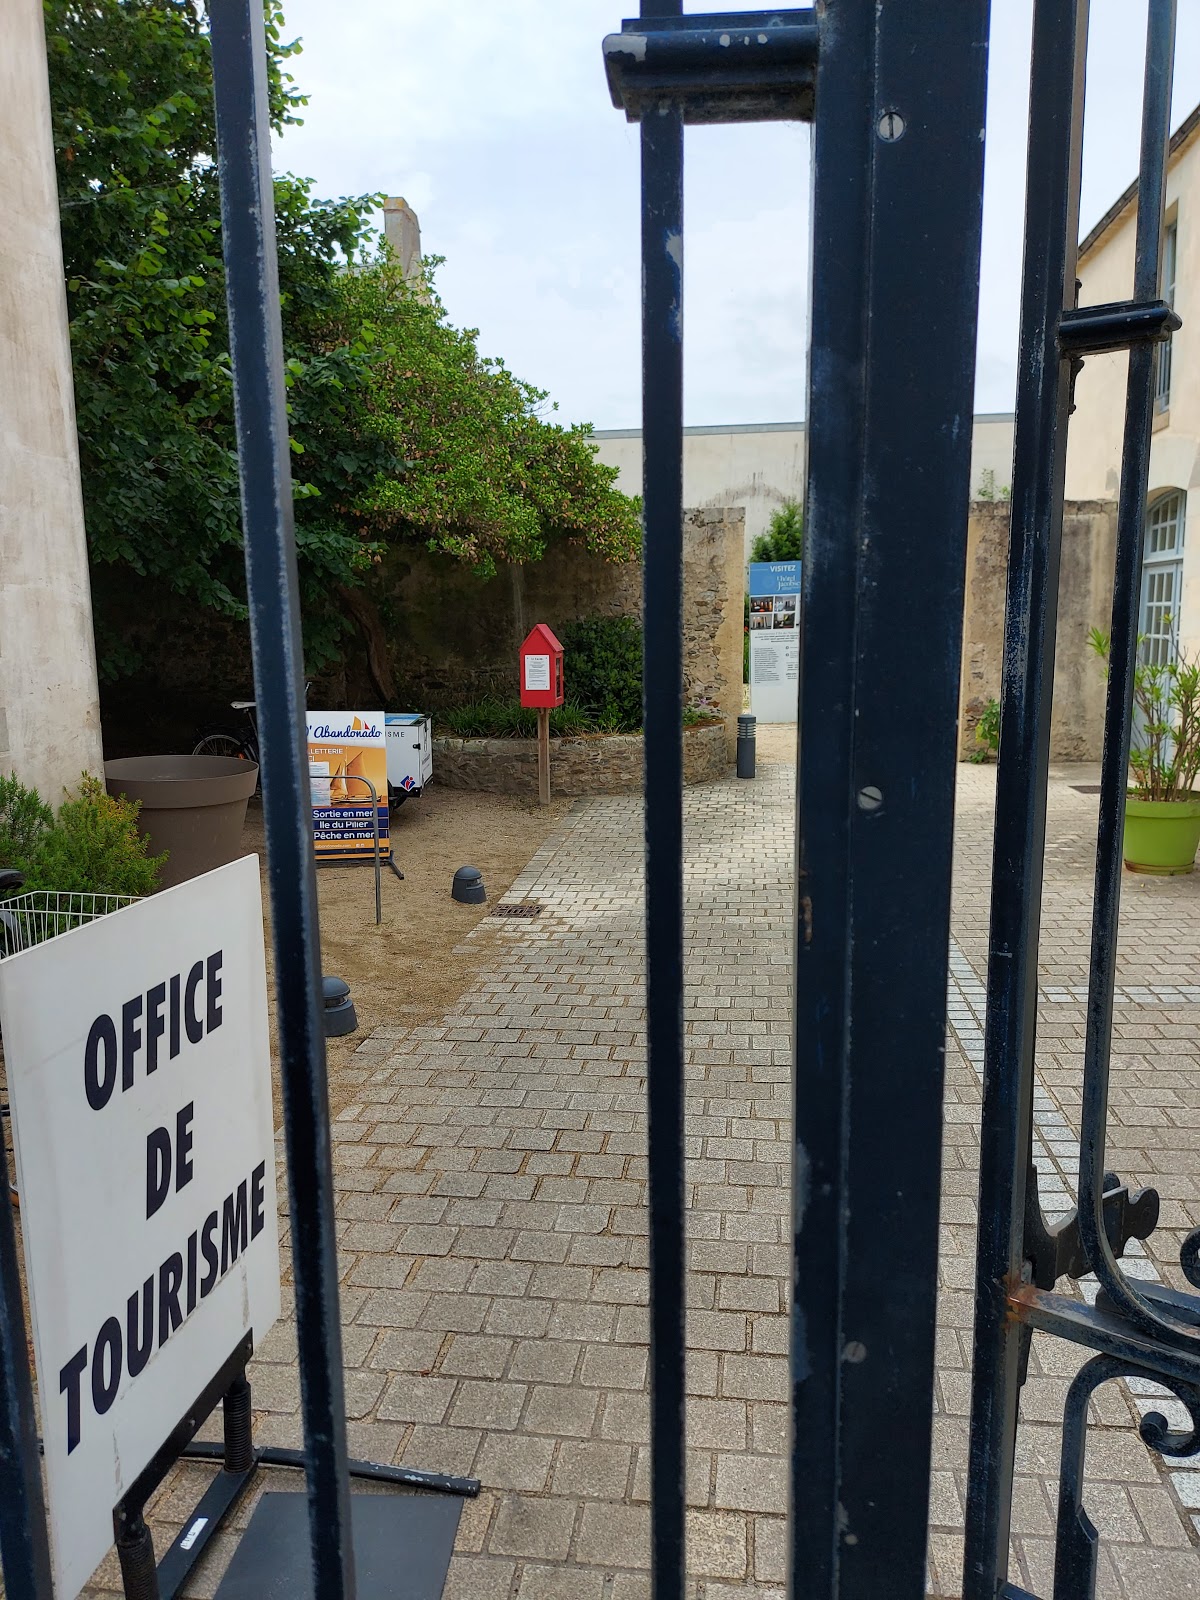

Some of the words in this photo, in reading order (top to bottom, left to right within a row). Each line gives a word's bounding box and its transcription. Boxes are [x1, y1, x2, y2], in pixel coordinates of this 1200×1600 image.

[770, 565, 796, 573] VISITEZ
[313, 810, 341, 818] Sortie
[331, 820, 344, 829] du
[313, 831, 342, 840] Pêche
[356, 831, 375, 839] mer
[84, 949, 223, 1111] OFFICE
[146, 1101, 194, 1221] DE
[59, 1159, 266, 1456] TOURISME
